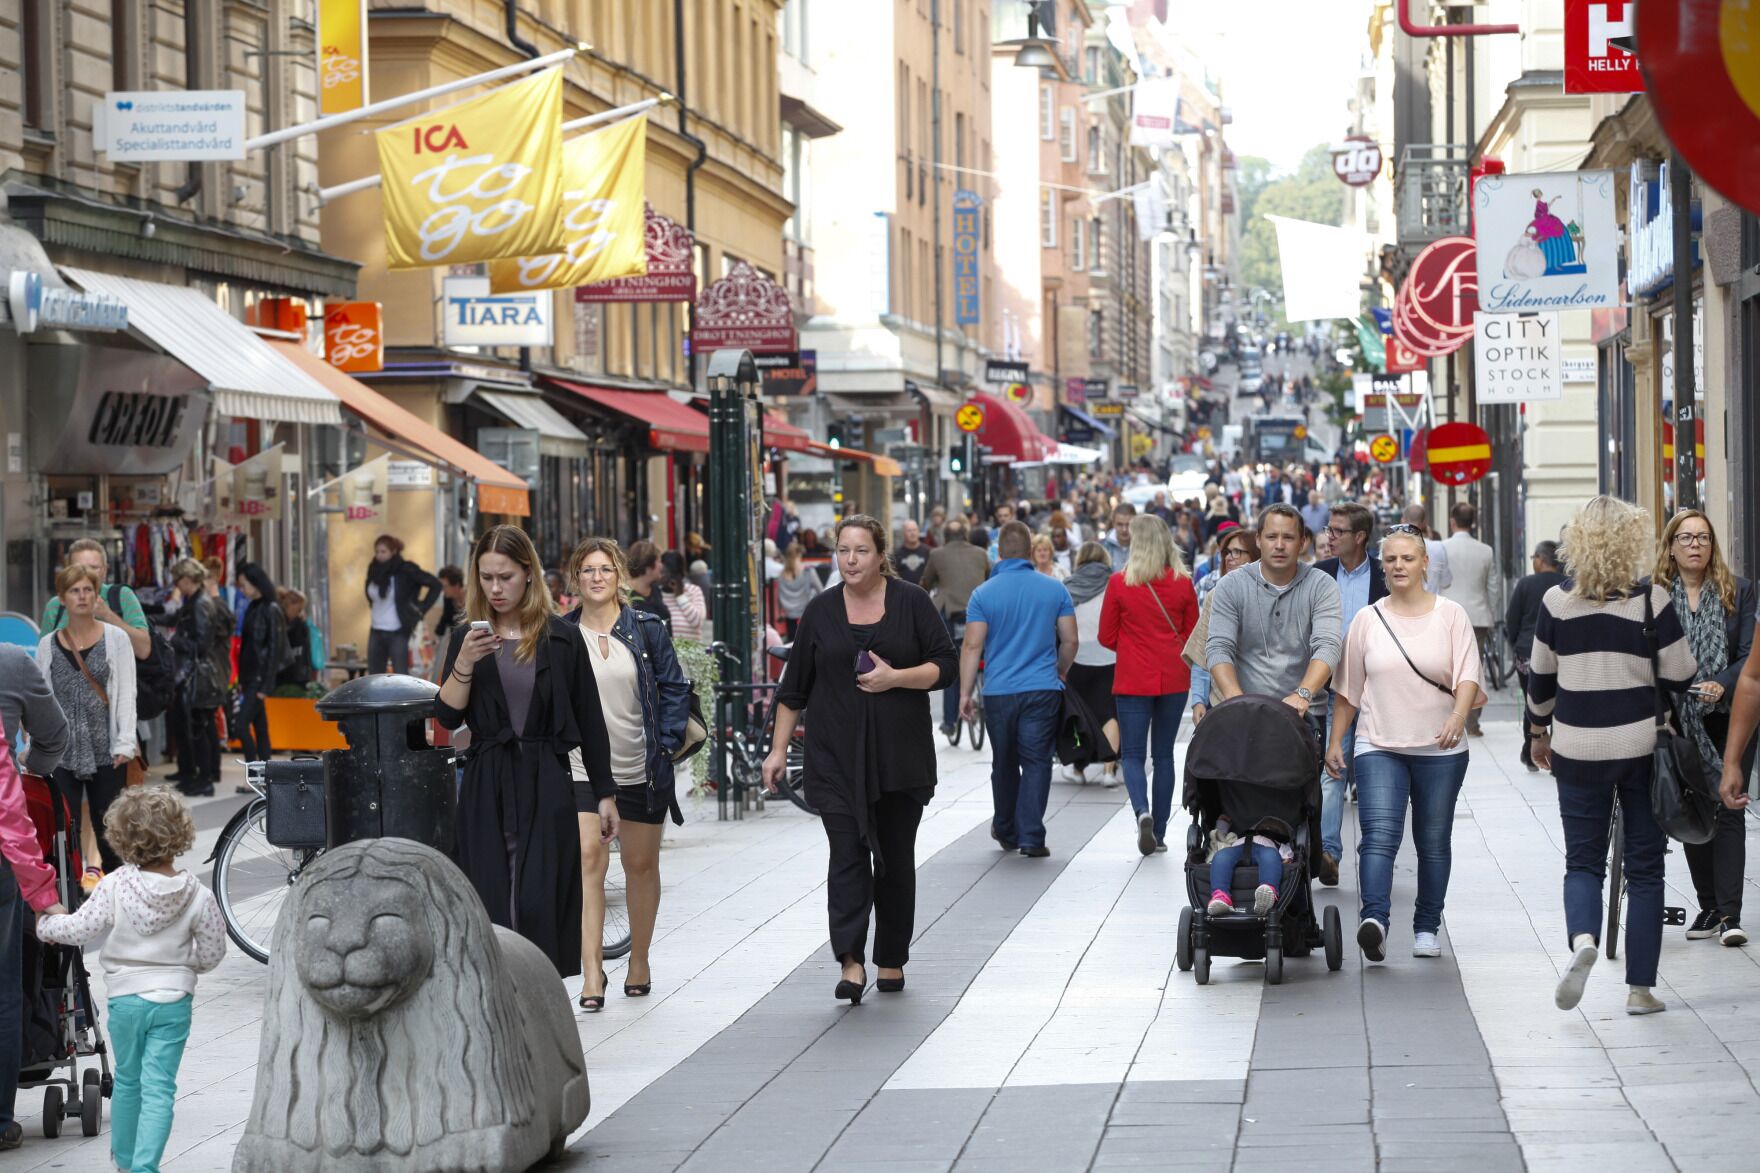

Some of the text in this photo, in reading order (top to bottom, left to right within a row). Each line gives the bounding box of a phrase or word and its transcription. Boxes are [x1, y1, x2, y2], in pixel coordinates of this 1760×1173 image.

[1588, 59, 1630, 71] HELLY
[130, 120, 217, 134] Akuttandvård
[116, 137, 233, 152] Specialisttandvård
[414, 124, 469, 155] ICA
[411, 154, 532, 203] to
[418, 199, 534, 261] go
[956, 213, 977, 318] HOTEL
[1488, 283, 1607, 310] Sidencarlson
[328, 323, 377, 344] to
[1485, 320, 1550, 340] CITY
[330, 343, 378, 366] go
[1486, 346, 1550, 362] OPTIK
[1488, 368, 1550, 381] STOCK
[1488, 385, 1551, 395] HOLM
